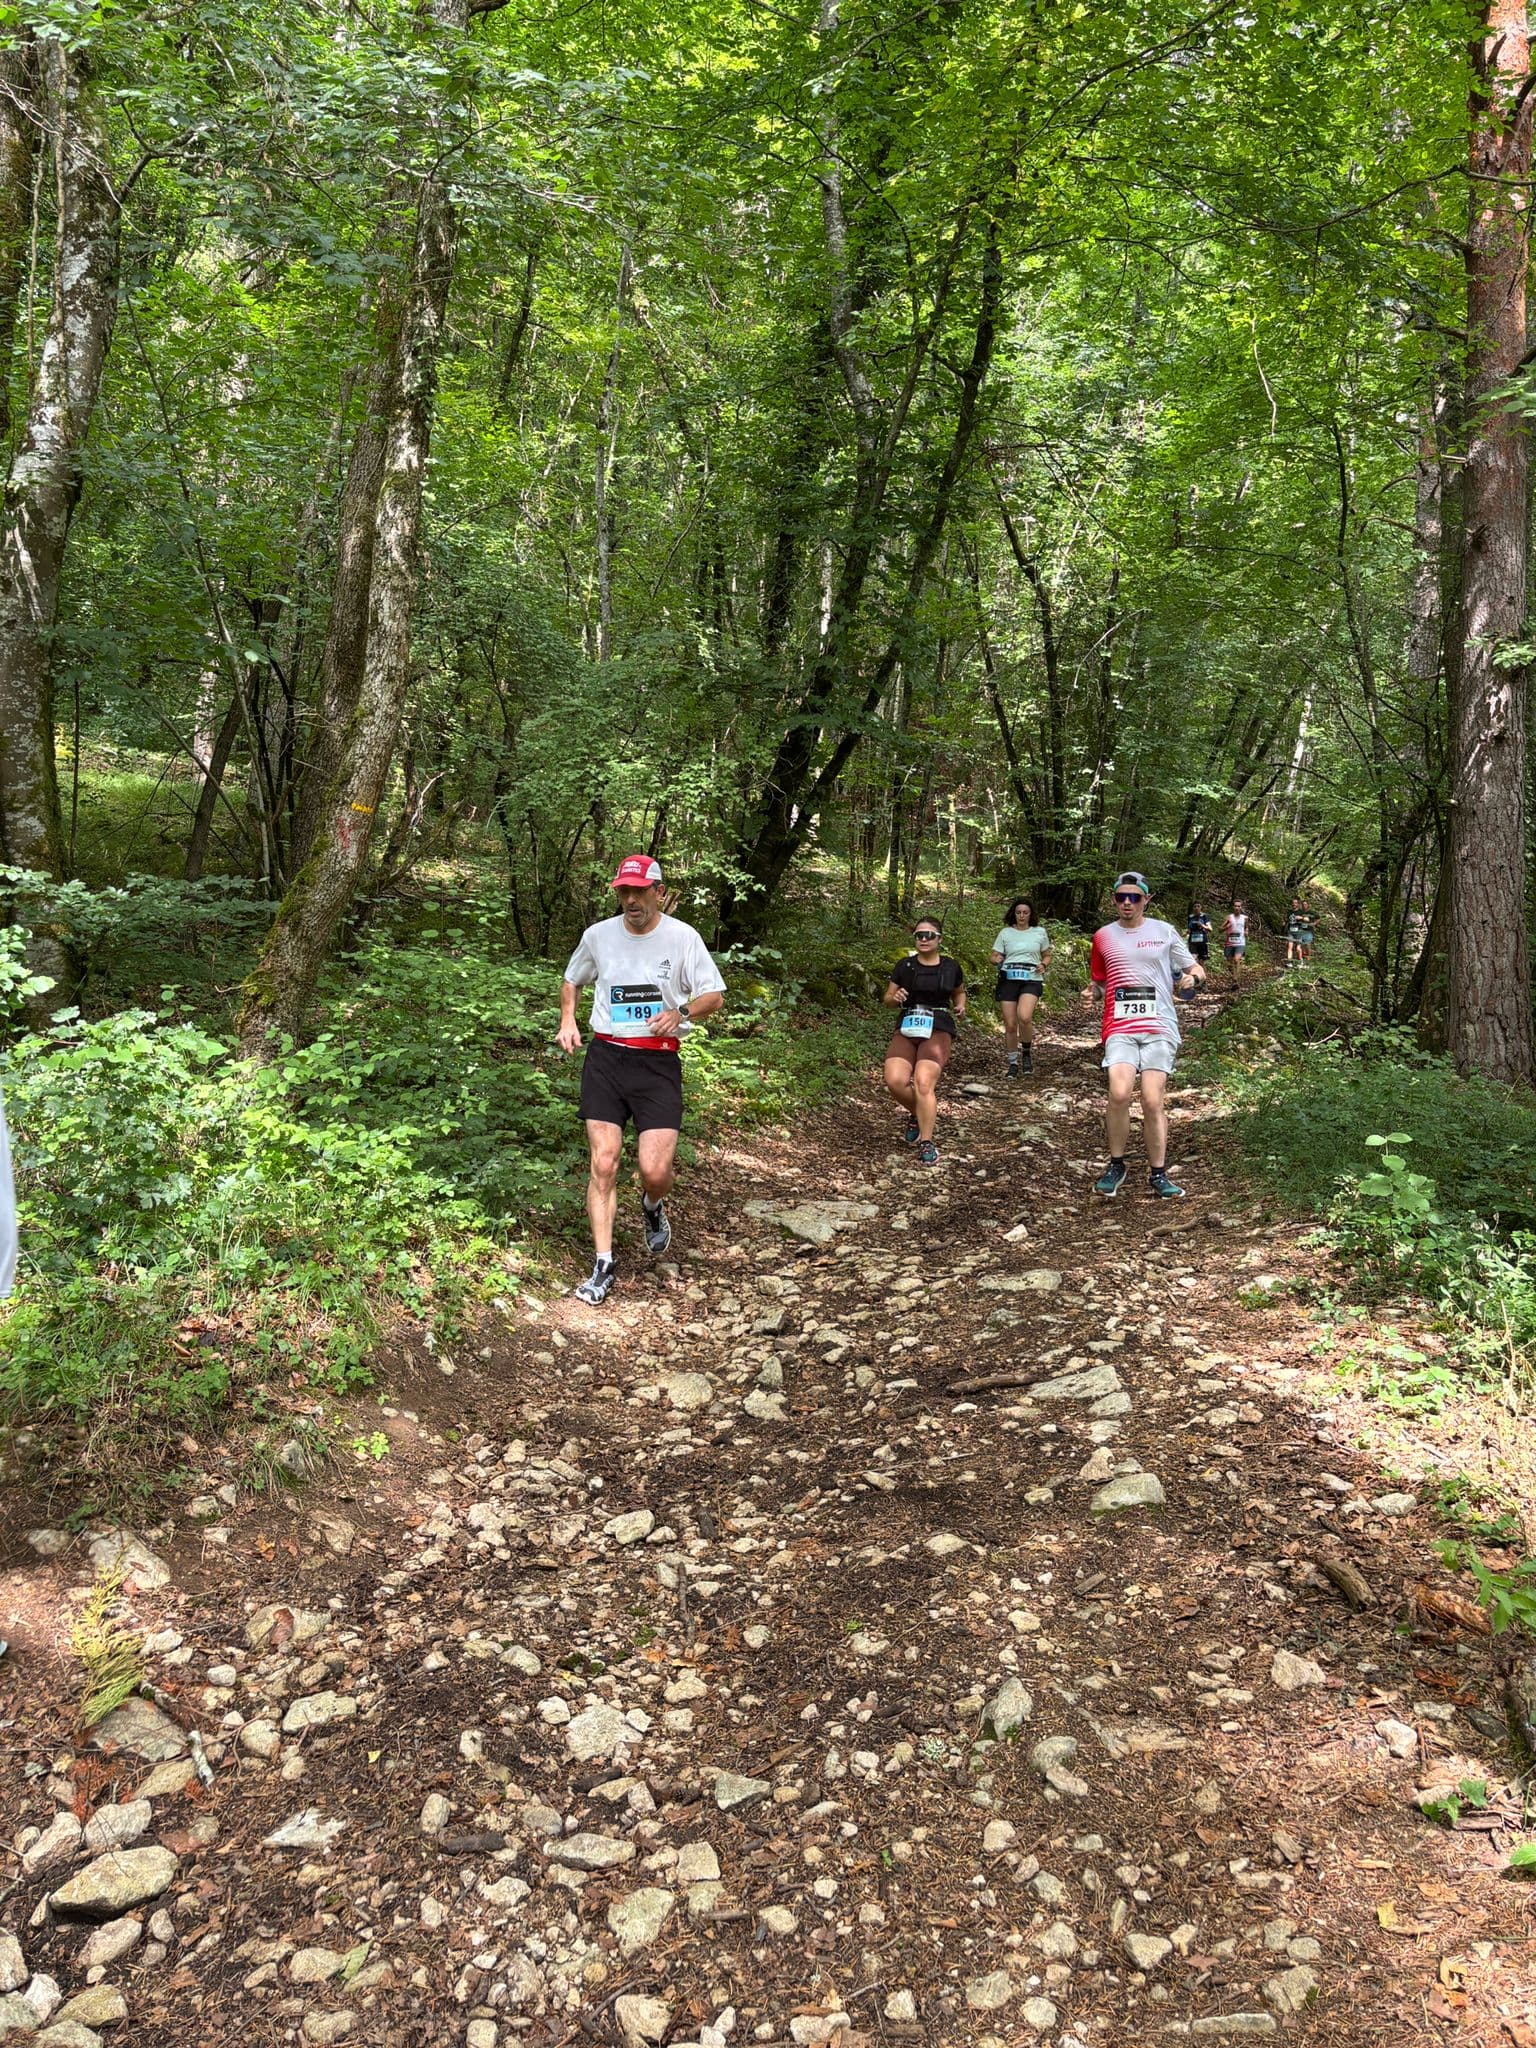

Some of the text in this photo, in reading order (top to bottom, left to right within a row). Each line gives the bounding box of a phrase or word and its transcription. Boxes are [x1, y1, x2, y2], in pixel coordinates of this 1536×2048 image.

[626, 1006, 652, 1019] 189
[1123, 1003, 1146, 1014] 738
[909, 1017, 926, 1026] 150
